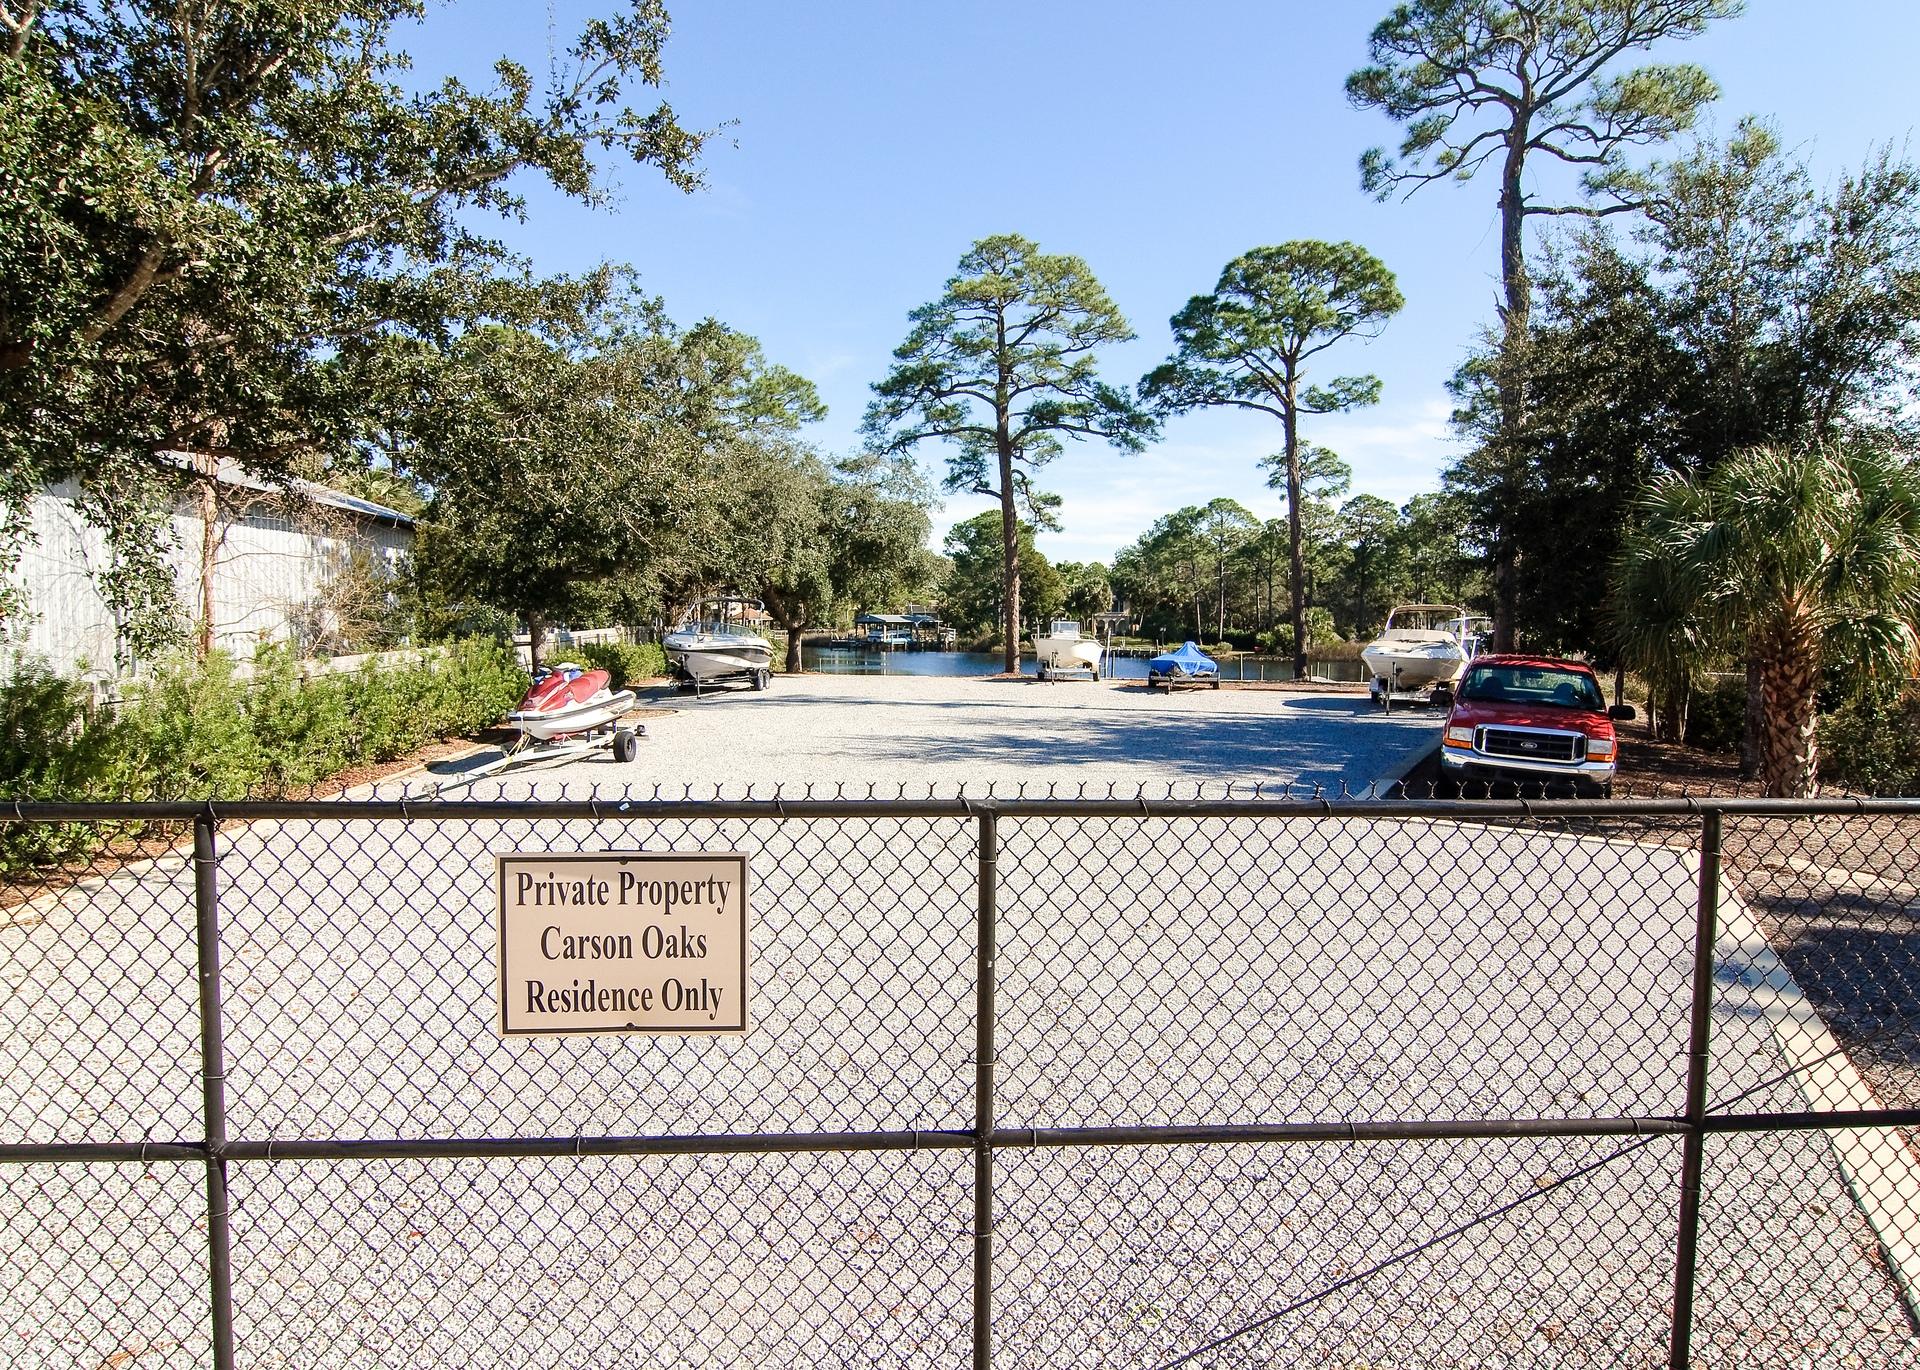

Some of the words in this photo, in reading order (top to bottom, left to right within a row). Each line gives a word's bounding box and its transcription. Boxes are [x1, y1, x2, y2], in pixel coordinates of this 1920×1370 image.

[516, 872, 609, 906] Private
[618, 871, 731, 915] Property
[540, 926, 632, 960] Carson
[642, 925, 707, 959] Oaks
[525, 979, 653, 1013] Residence
[661, 978, 723, 1020] Only
